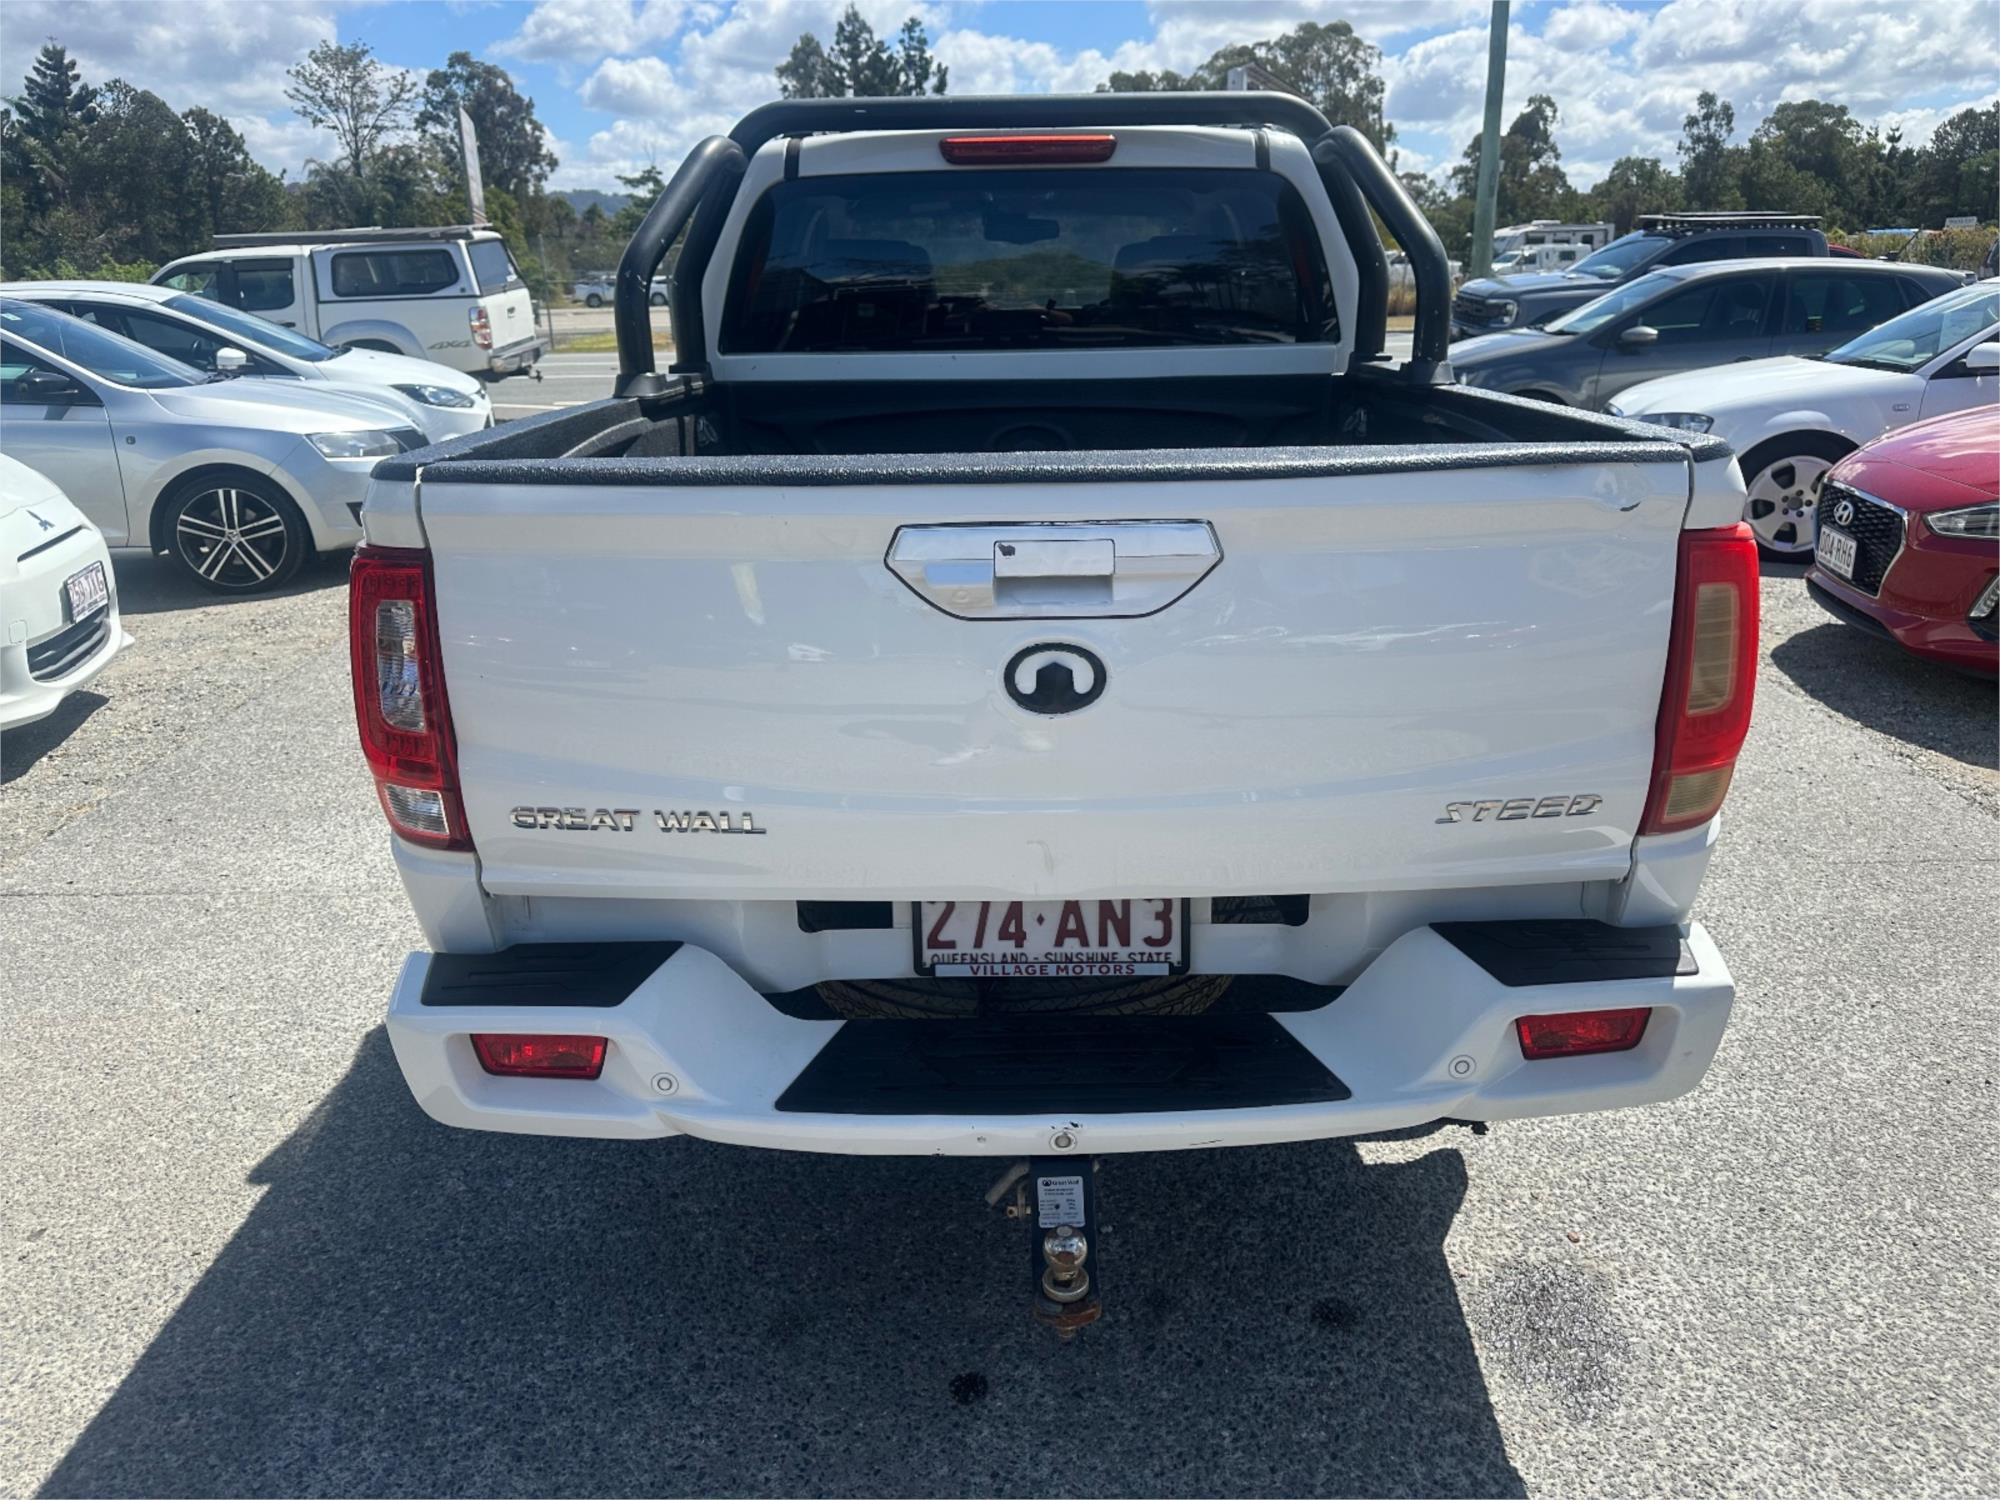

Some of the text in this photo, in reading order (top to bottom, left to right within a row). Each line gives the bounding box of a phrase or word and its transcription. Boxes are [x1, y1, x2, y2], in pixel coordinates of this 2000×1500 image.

[1435, 793, 1603, 824] STEED
[510, 806, 767, 835] GREAT WALL
[930, 952, 1029, 963] QUEENSLAND
[1044, 952, 1119, 963] SUNSHINE
[1127, 952, 1173, 963] STATE
[969, 964, 1136, 976] VILLAGE MOTORS
